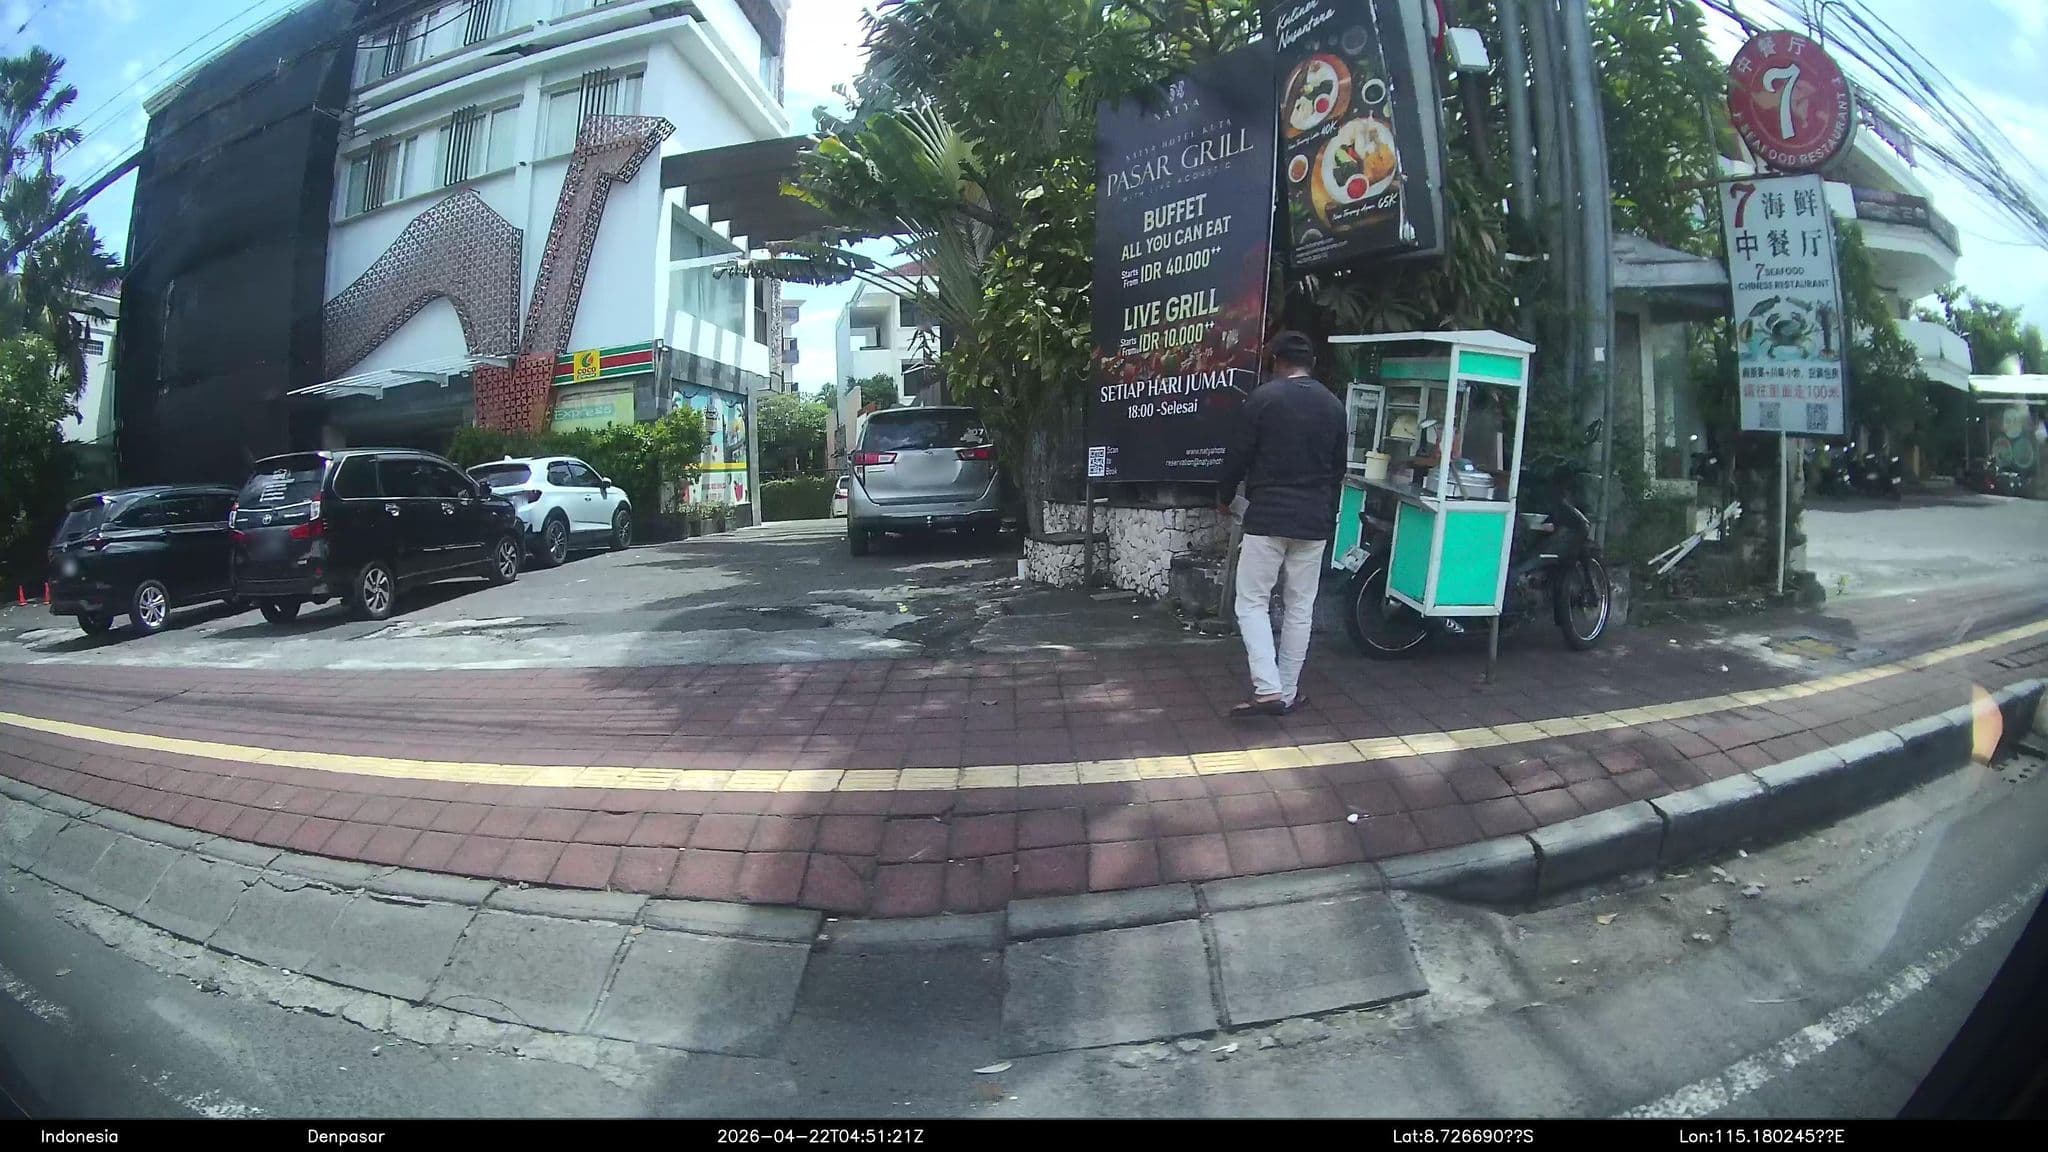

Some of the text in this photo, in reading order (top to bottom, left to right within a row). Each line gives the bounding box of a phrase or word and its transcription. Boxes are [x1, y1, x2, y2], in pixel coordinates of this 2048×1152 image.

[1763, 64, 1800, 140] 7
[1107, 154, 1173, 197] PASAR
[1181, 128, 1254, 169] GRILL
[1143, 193, 1207, 233] BUFFET
[1730, 183, 1818, 228] 7 海鲜
[1120, 215, 1232, 262] ALL YOU CAN EAT
[1736, 229, 1824, 261] 中餐厅
[1121, 268, 1139, 279] Starts
[1140, 262, 1162, 283] IDR
[1755, 263, 1805, 280] 7 SEAFOOD
[1123, 278, 1139, 289] From
[1774, 278, 1830, 289] RESTAURANT
[1123, 288, 1221, 332] LIVE GRILL
[1120, 337, 1137, 347] Starts
[1138, 332, 1160, 353] IDR
[577, 366, 597, 375] COCO
[1100, 367, 1238, 403] SETIAP HARI JUMAT
[1127, 403, 1154, 419] 18:00
